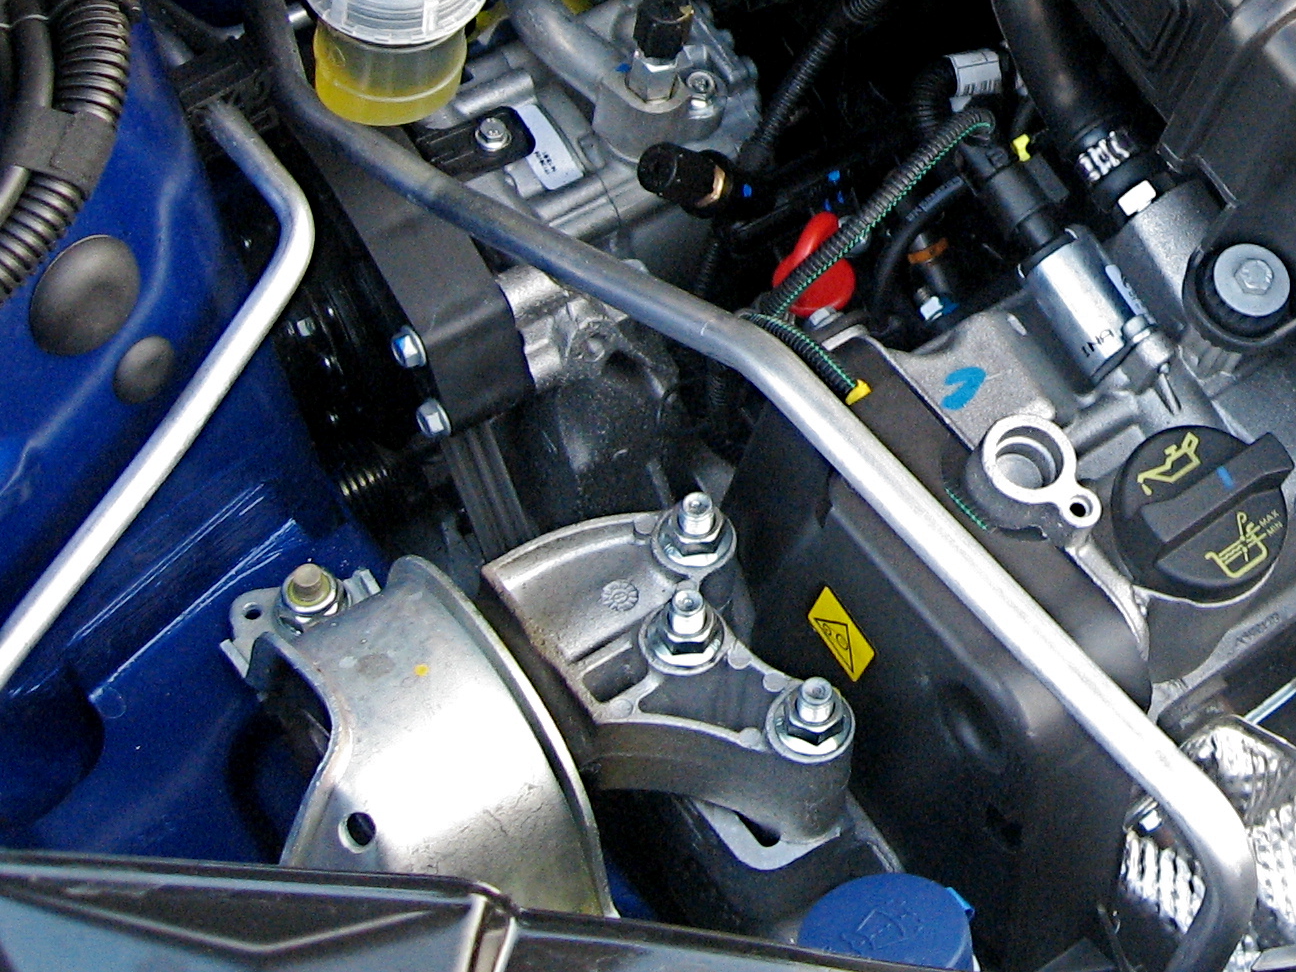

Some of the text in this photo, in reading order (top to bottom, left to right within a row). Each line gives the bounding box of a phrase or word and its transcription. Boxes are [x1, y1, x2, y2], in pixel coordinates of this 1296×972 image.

[1080, 330, 1114, 358] INA
[1259, 509, 1280, 528] MAX
[1266, 521, 1284, 538] MIN
